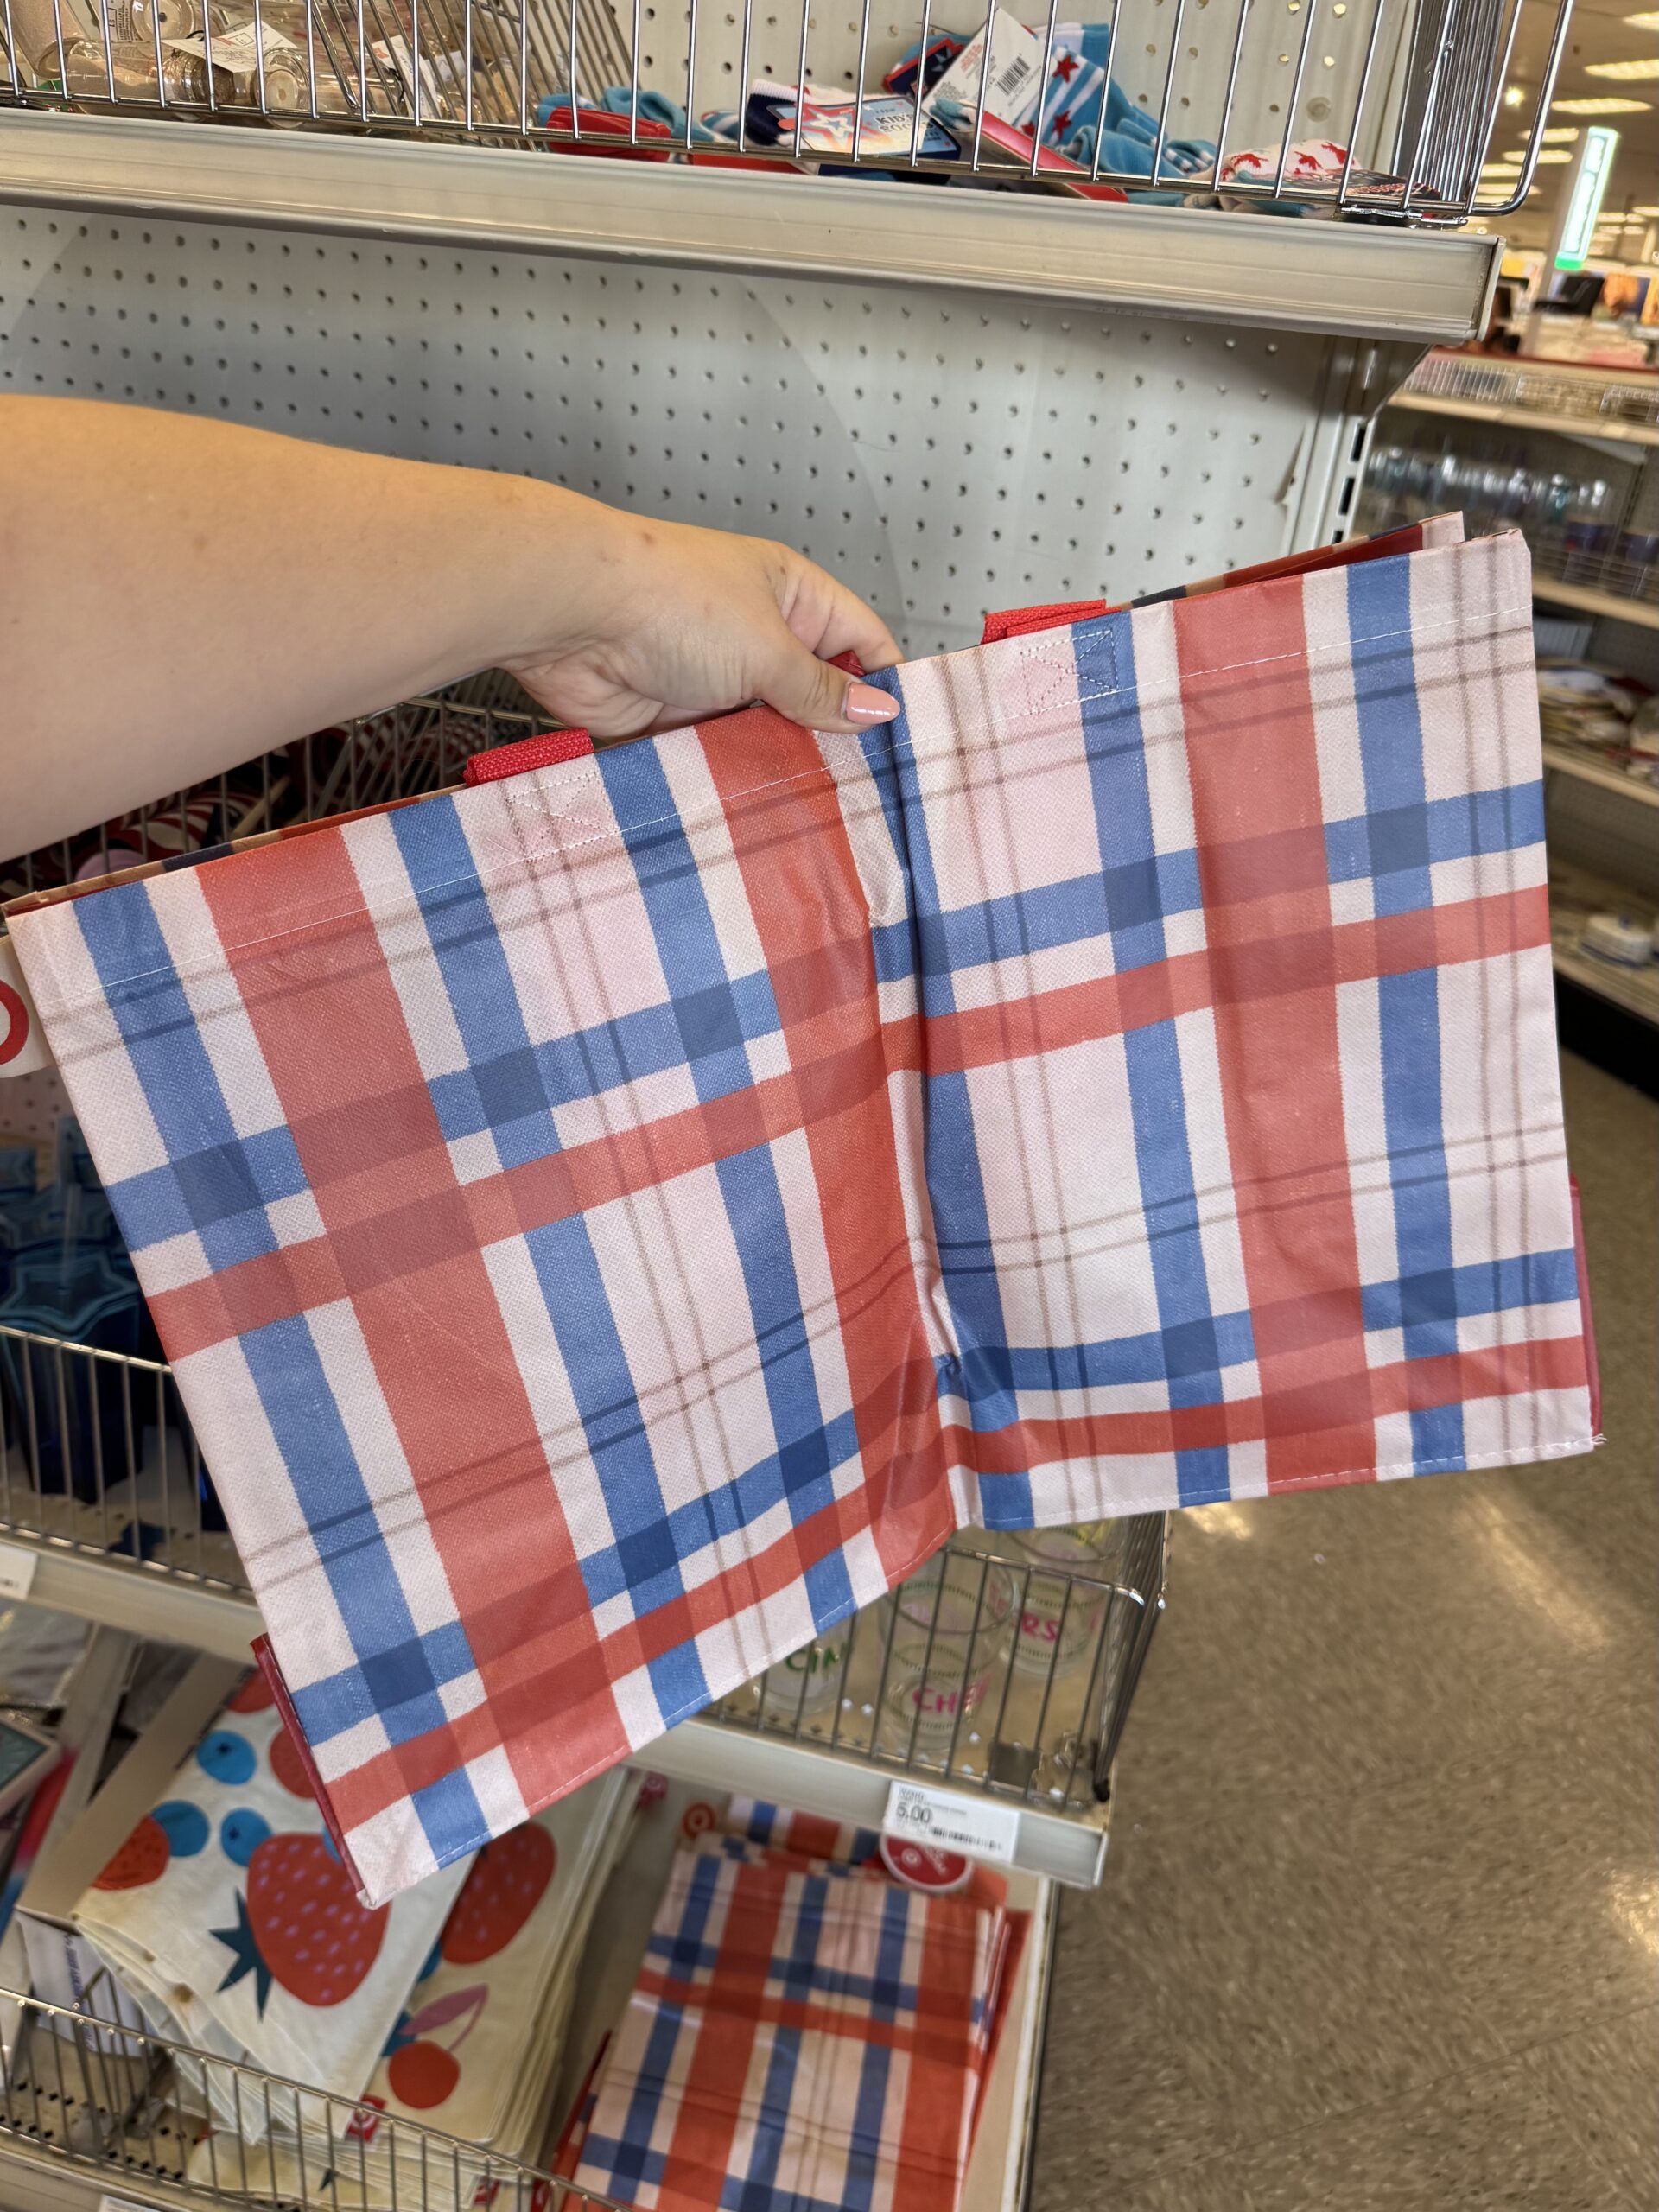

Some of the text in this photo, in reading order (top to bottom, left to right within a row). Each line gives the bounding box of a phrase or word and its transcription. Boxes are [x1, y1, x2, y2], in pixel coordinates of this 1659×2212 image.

[875, 113, 916, 124] KID'S
[880, 122, 934, 132] SOCS
[896, 1802, 931, 1824] 5.00
